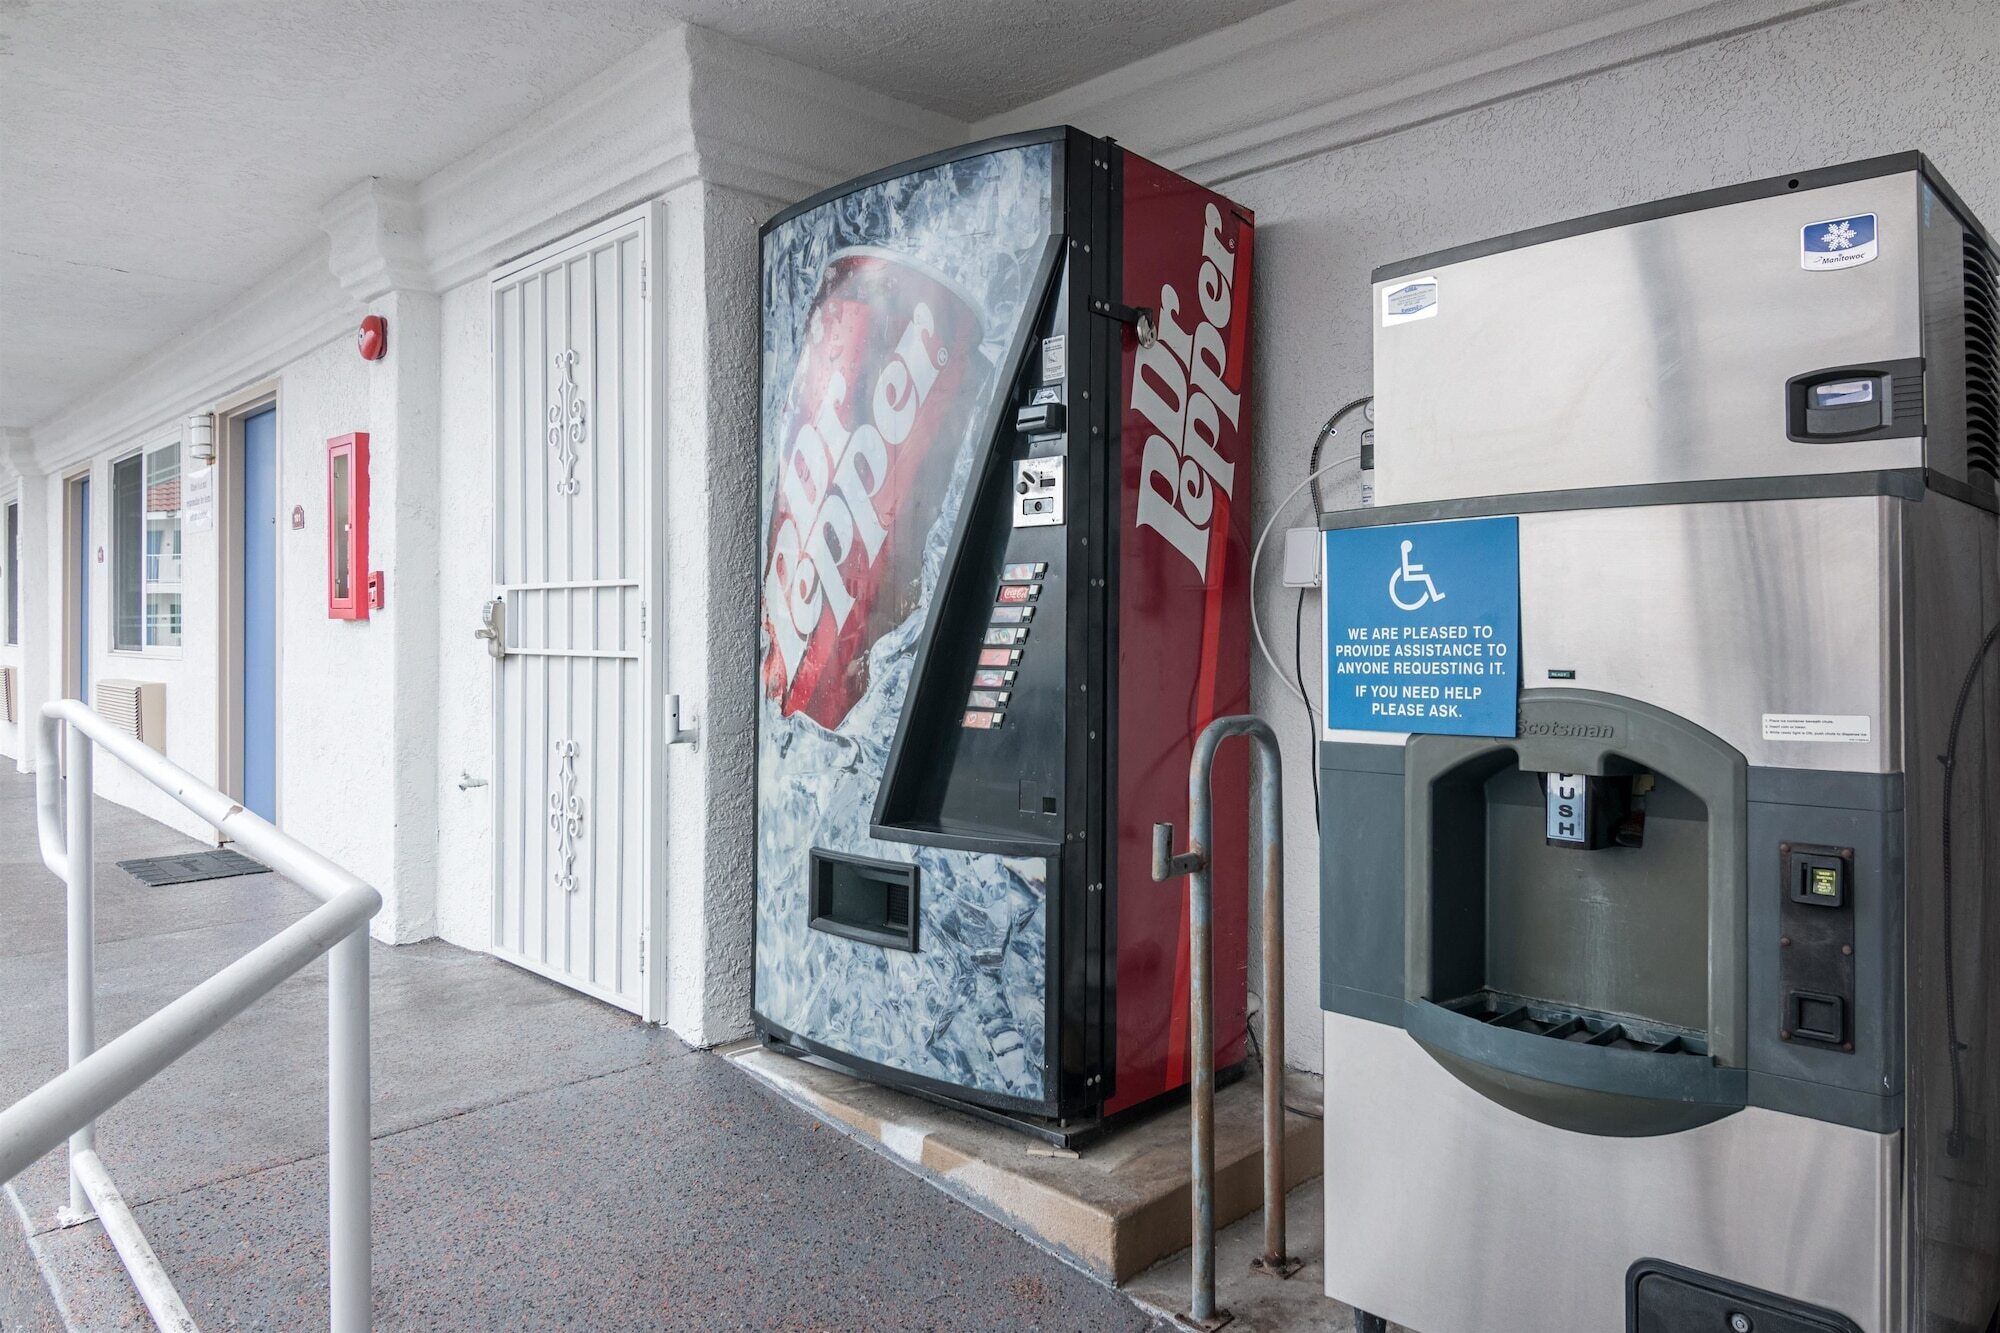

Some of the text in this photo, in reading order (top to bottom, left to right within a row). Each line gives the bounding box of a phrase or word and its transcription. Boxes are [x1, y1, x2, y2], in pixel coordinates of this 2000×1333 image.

[1821, 253, 1865, 264] Manitowoc
[1131, 284, 1192, 456] Dr
[1136, 202, 1242, 584] Pepper
[783, 371, 852, 547] Dr
[766, 302, 942, 690] Pepper
[1348, 626, 1493, 639] WE ARE PLEASED TO
[1336, 644, 1507, 656] PROVIDE ASSISTANCE TO
[1338, 662, 1506, 675] ANYONE REQUESTING IT.
[1356, 686, 1482, 699] IF YOU NEED HELP
[1373, 703, 1463, 718] PLEASE ASK.
[1558, 773, 1576, 837] PUSH
